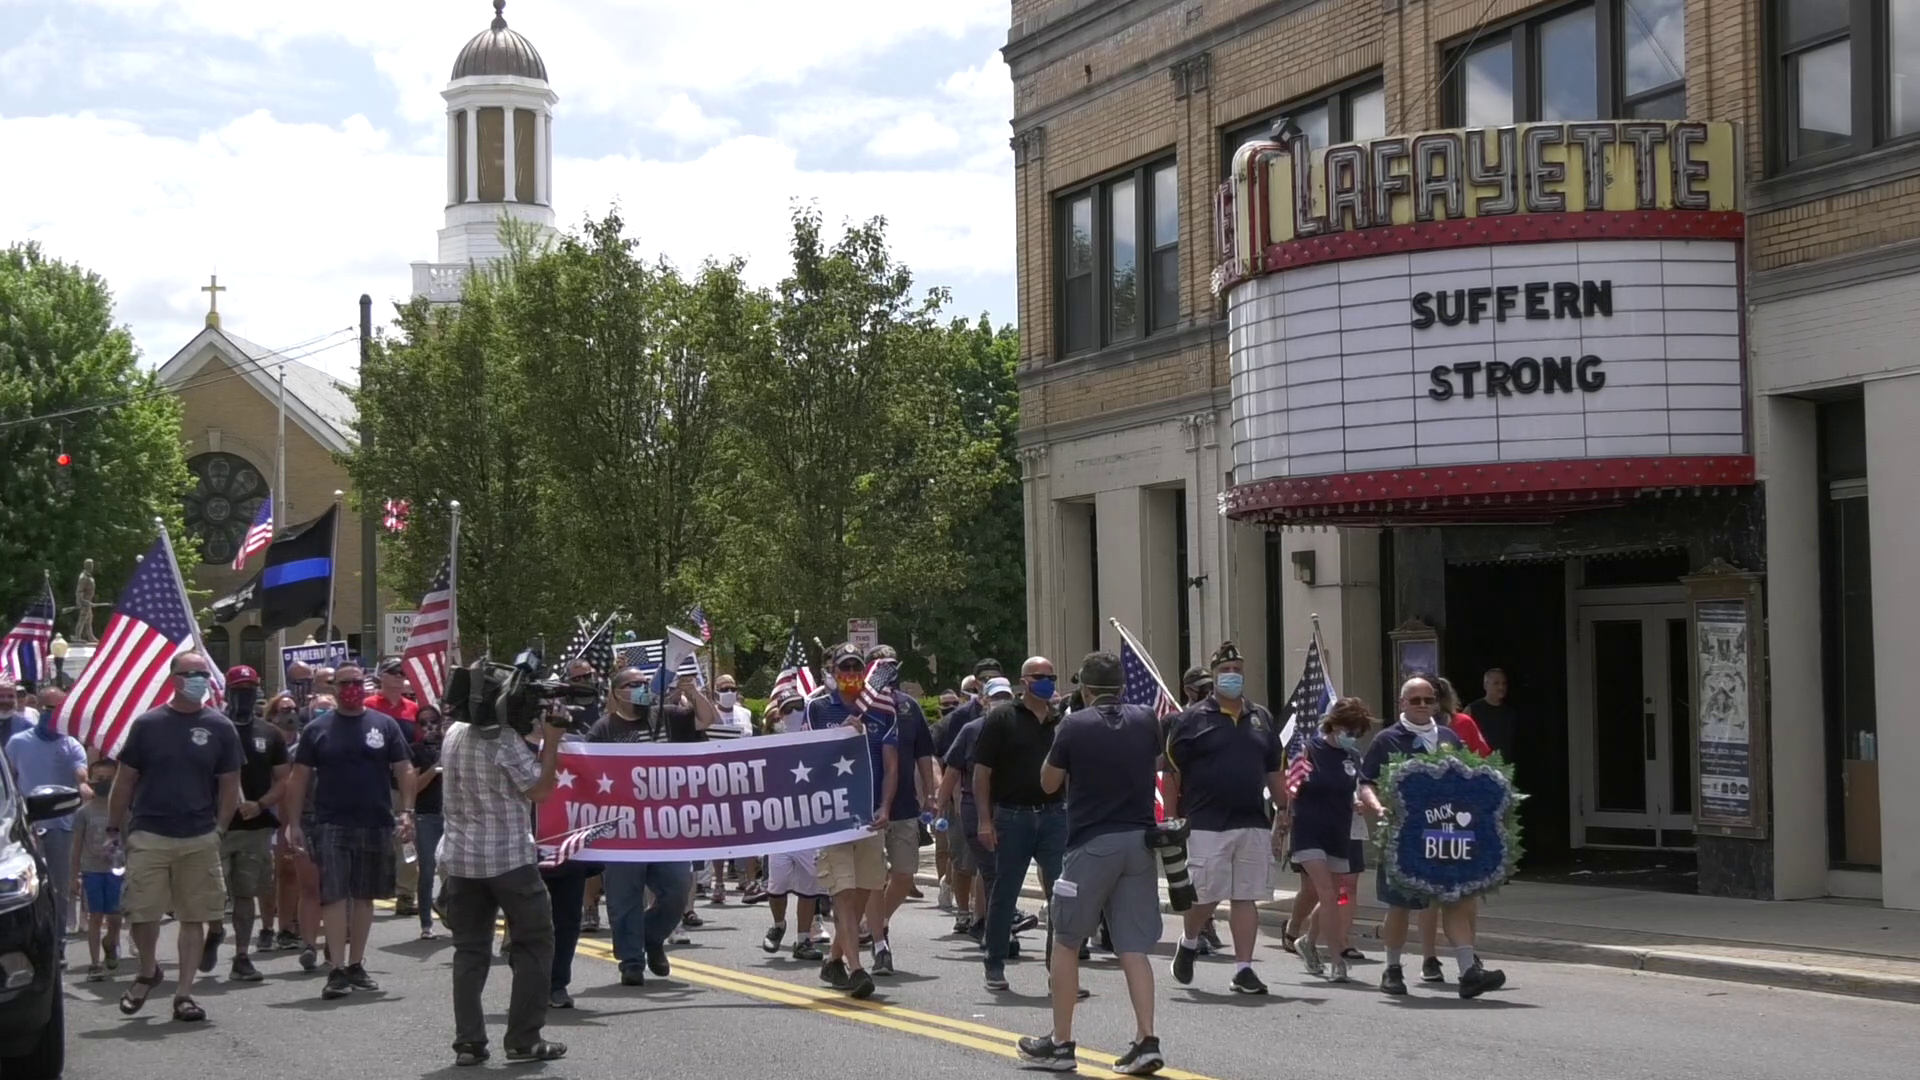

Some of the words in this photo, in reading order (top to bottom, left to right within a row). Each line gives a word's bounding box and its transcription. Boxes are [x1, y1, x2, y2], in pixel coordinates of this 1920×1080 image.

[1291, 123, 1710, 236] LAFAYETTE
[1411, 280, 1613, 330] SUFFERN
[1428, 355, 1606, 401] STRONG
[394, 616, 410, 624] NO
[293, 646, 337, 661] AMERIA
[631, 759, 766, 801] SUPPORT
[566, 801, 636, 839] YOUR
[644, 802, 737, 839] LOCAL
[743, 788, 850, 834] POLICE
[1425, 803, 1454, 824] BACK
[1441, 822, 1454, 834] THE
[1425, 837, 1472, 860] BLUE
